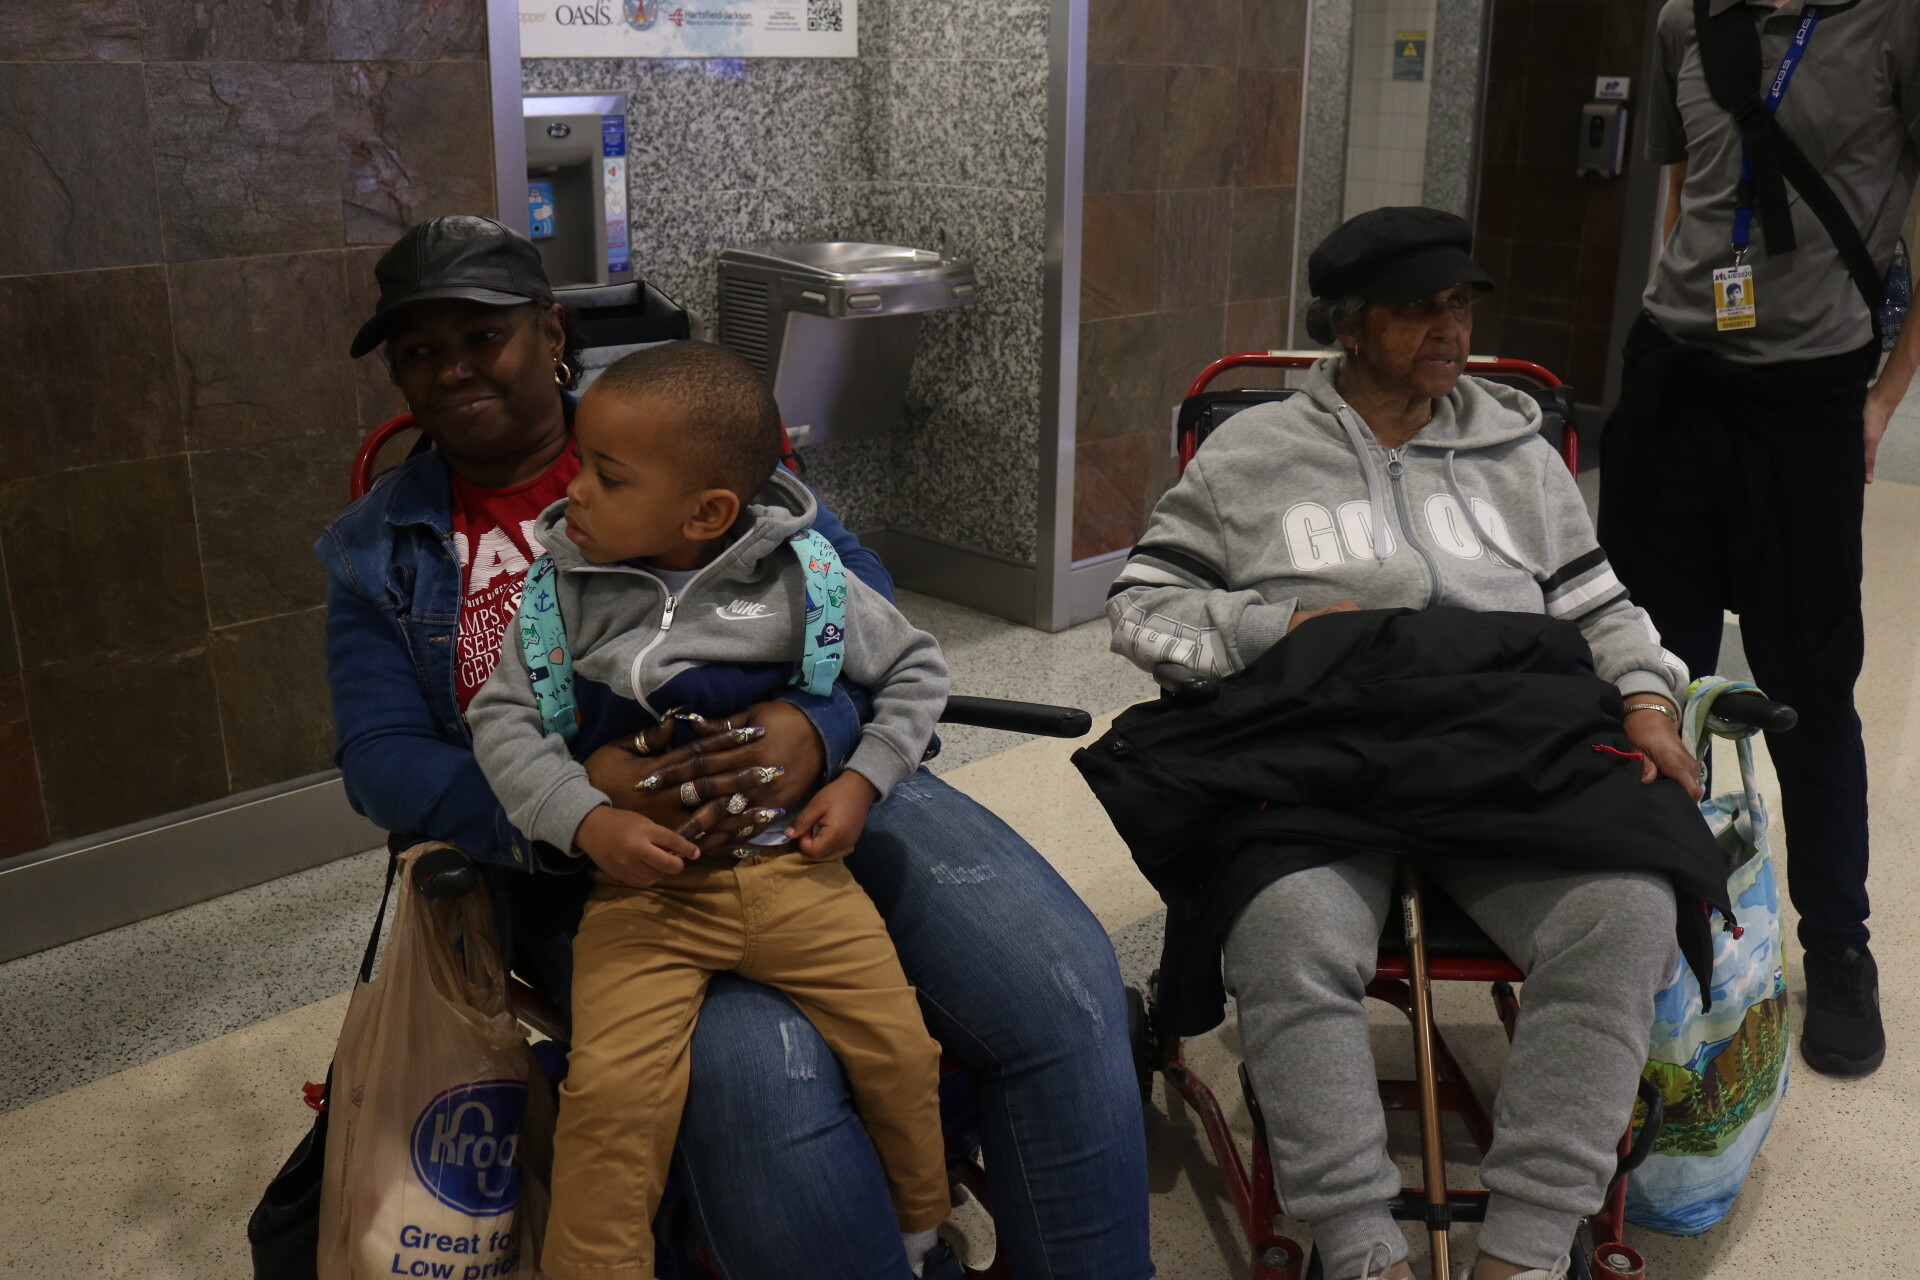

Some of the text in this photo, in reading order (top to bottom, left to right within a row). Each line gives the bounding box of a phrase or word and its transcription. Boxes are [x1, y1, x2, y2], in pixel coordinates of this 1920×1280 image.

[555, 1, 611, 26] OASIS
[726, 599, 768, 616] NIKE
[399, 1224, 481, 1255] Great
[391, 1253, 455, 1278] Low
